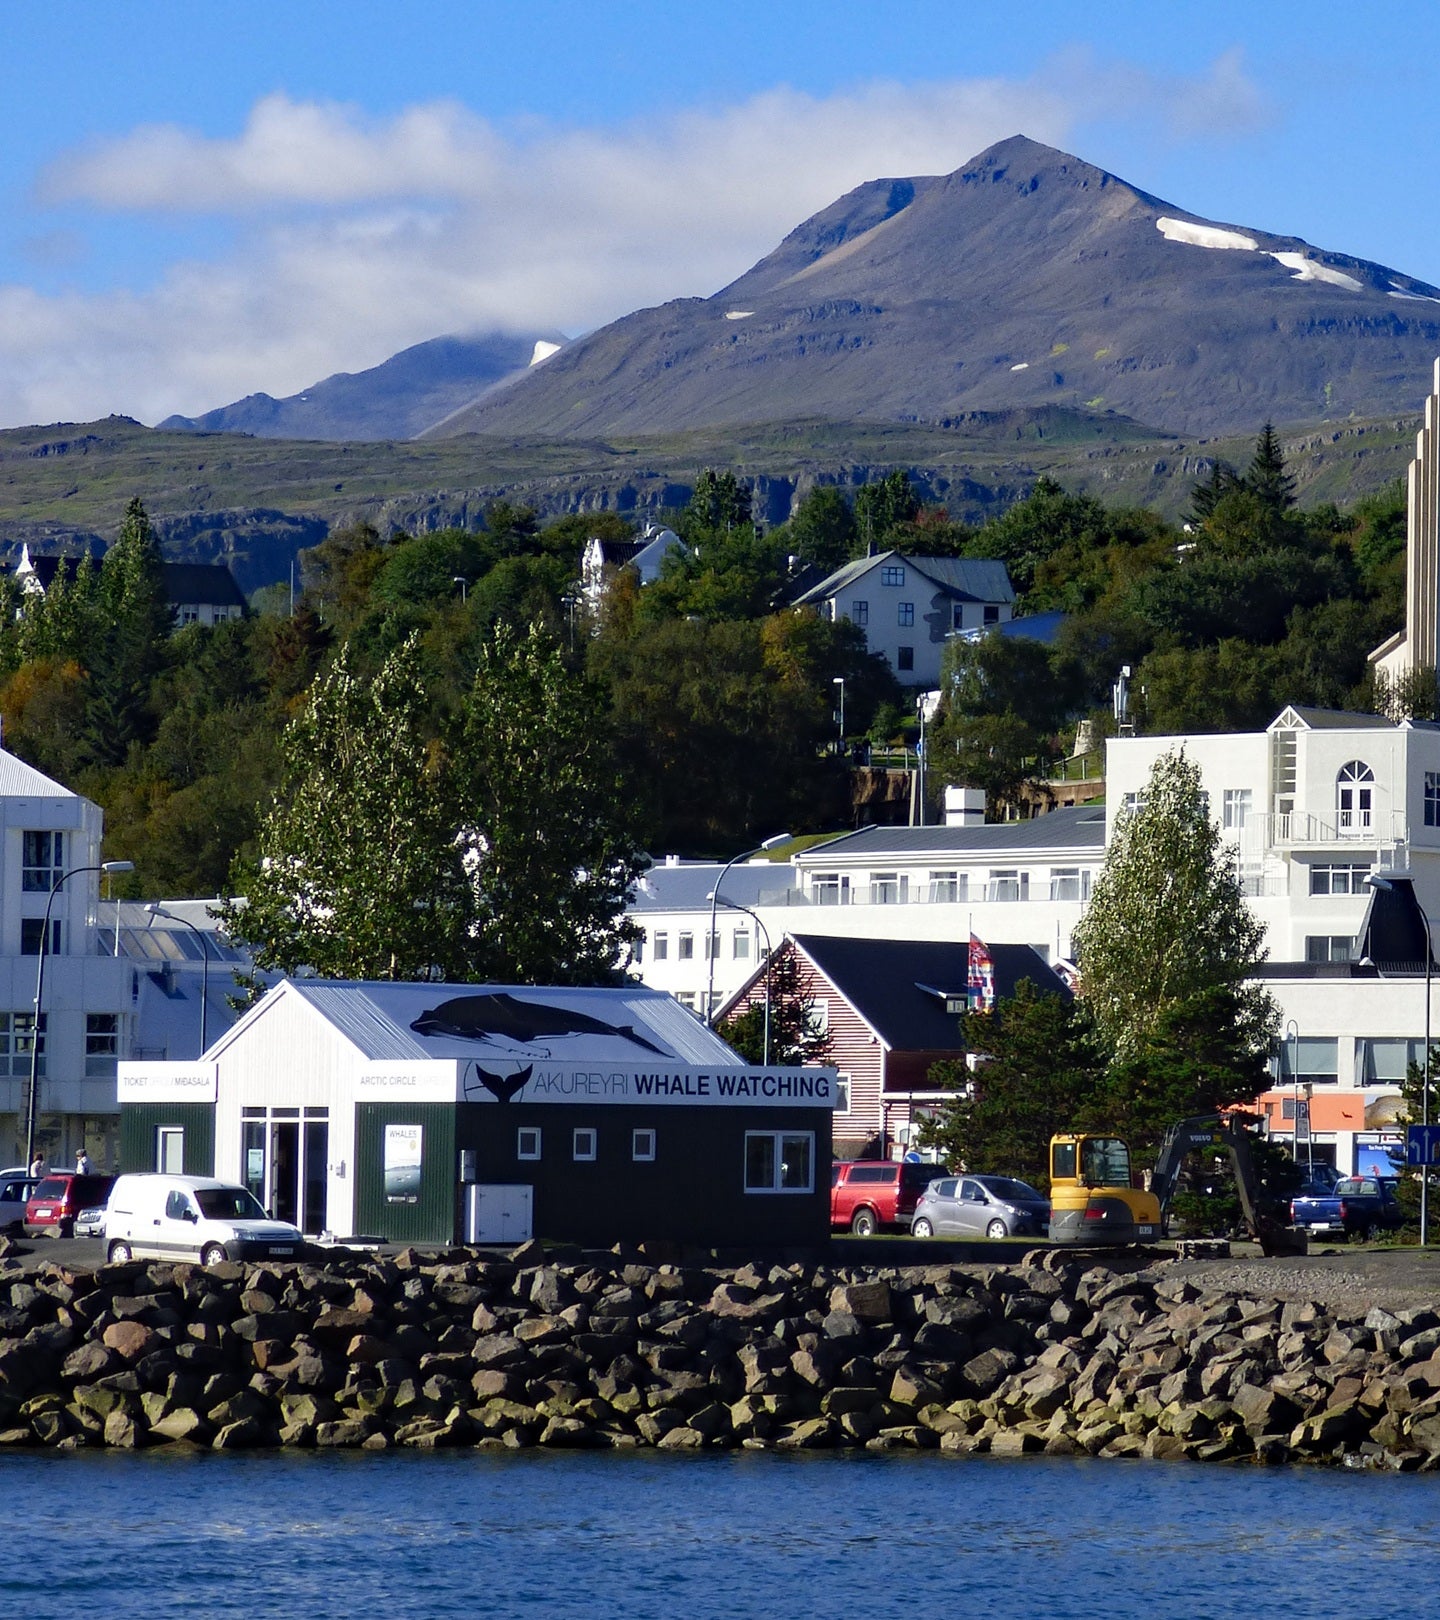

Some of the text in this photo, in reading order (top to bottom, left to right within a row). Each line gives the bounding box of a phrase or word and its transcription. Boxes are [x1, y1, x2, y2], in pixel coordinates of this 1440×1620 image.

[123, 1077, 148, 1086] TICKET
[360, 1076, 387, 1085] ARCTIC
[389, 1076, 416, 1085] CIRCLE
[533, 1072, 829, 1098] AKUREYRI WHALE WATCHING
[1300, 1103, 1306, 1118] P
